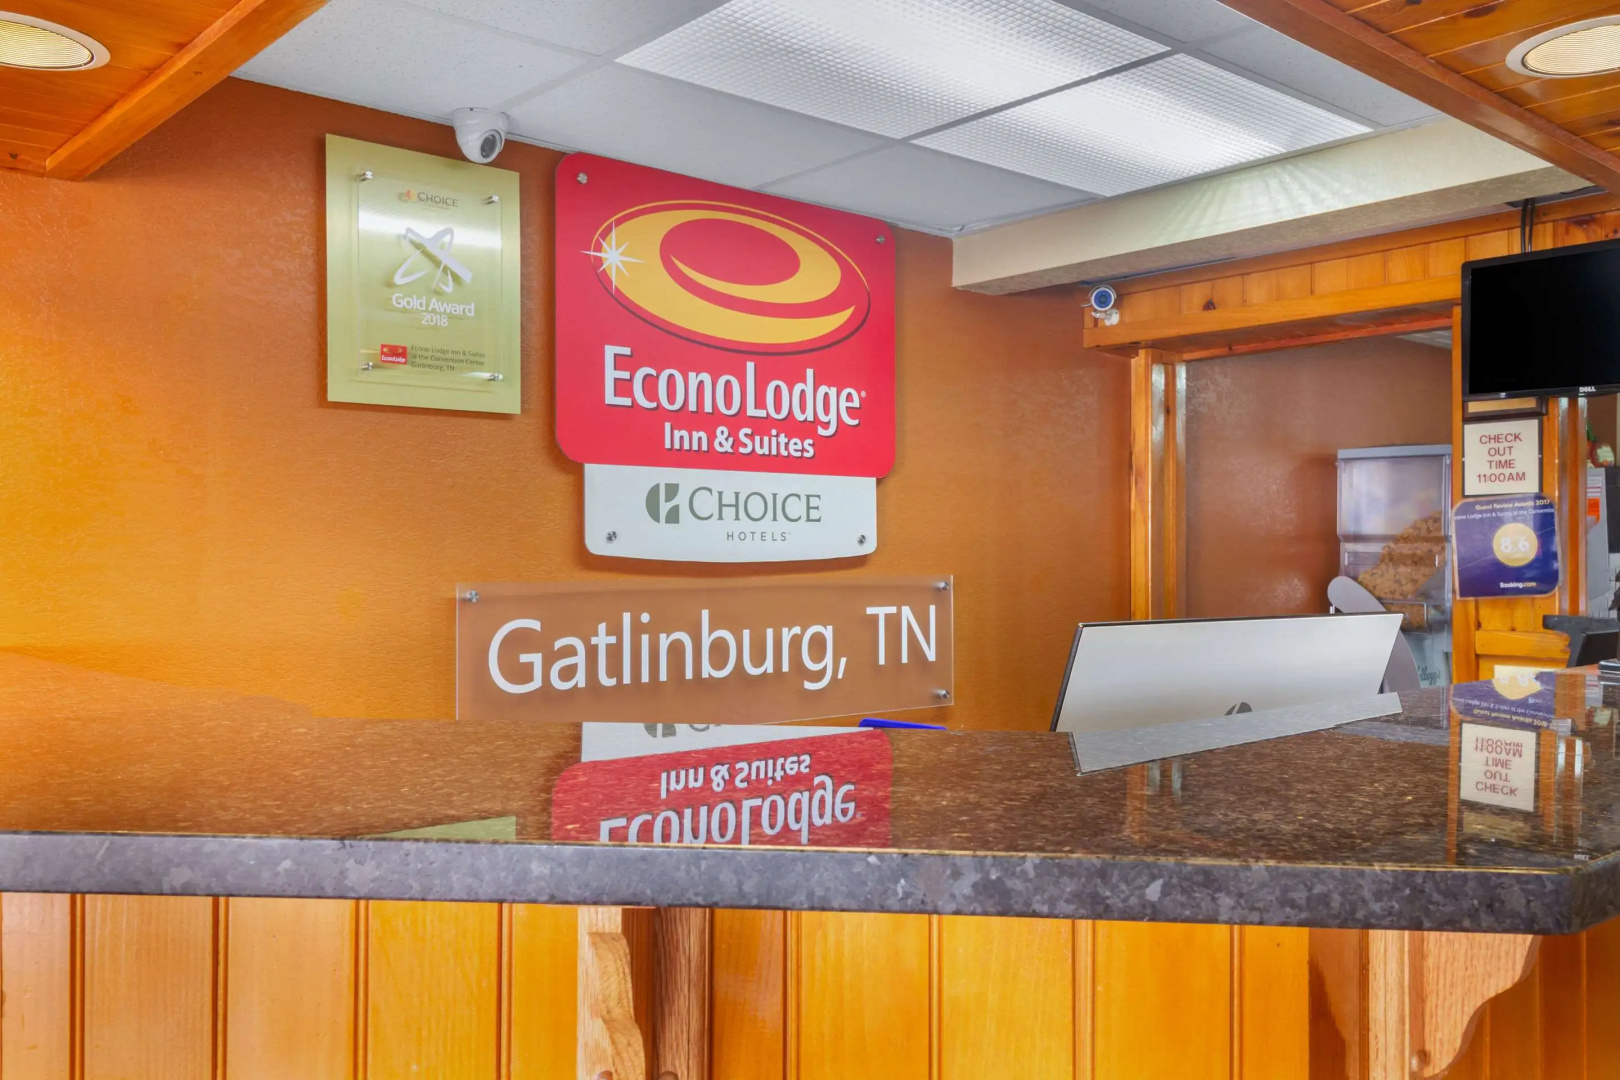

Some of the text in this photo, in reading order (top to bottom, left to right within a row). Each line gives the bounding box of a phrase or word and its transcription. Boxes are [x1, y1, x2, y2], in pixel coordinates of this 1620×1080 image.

[418, 192, 458, 207] CHOICE
[392, 293, 474, 316] Gold Award
[421, 312, 448, 326] 2018
[432, 346, 449, 355] Lodge
[468, 350, 486, 358] Suites
[430, 355, 465, 364] Convention
[664, 422, 815, 458] Inn & Suites
[1480, 432, 1522, 444] CHECK
[1488, 446, 1514, 456] OUT
[1487, 459, 1516, 470] TIME
[688, 486, 822, 523] CHOICE
[726, 531, 787, 541] HOTELS
[1500, 536, 1530, 553] 8.6
[488, 604, 936, 693] Gatlinburg, TN
